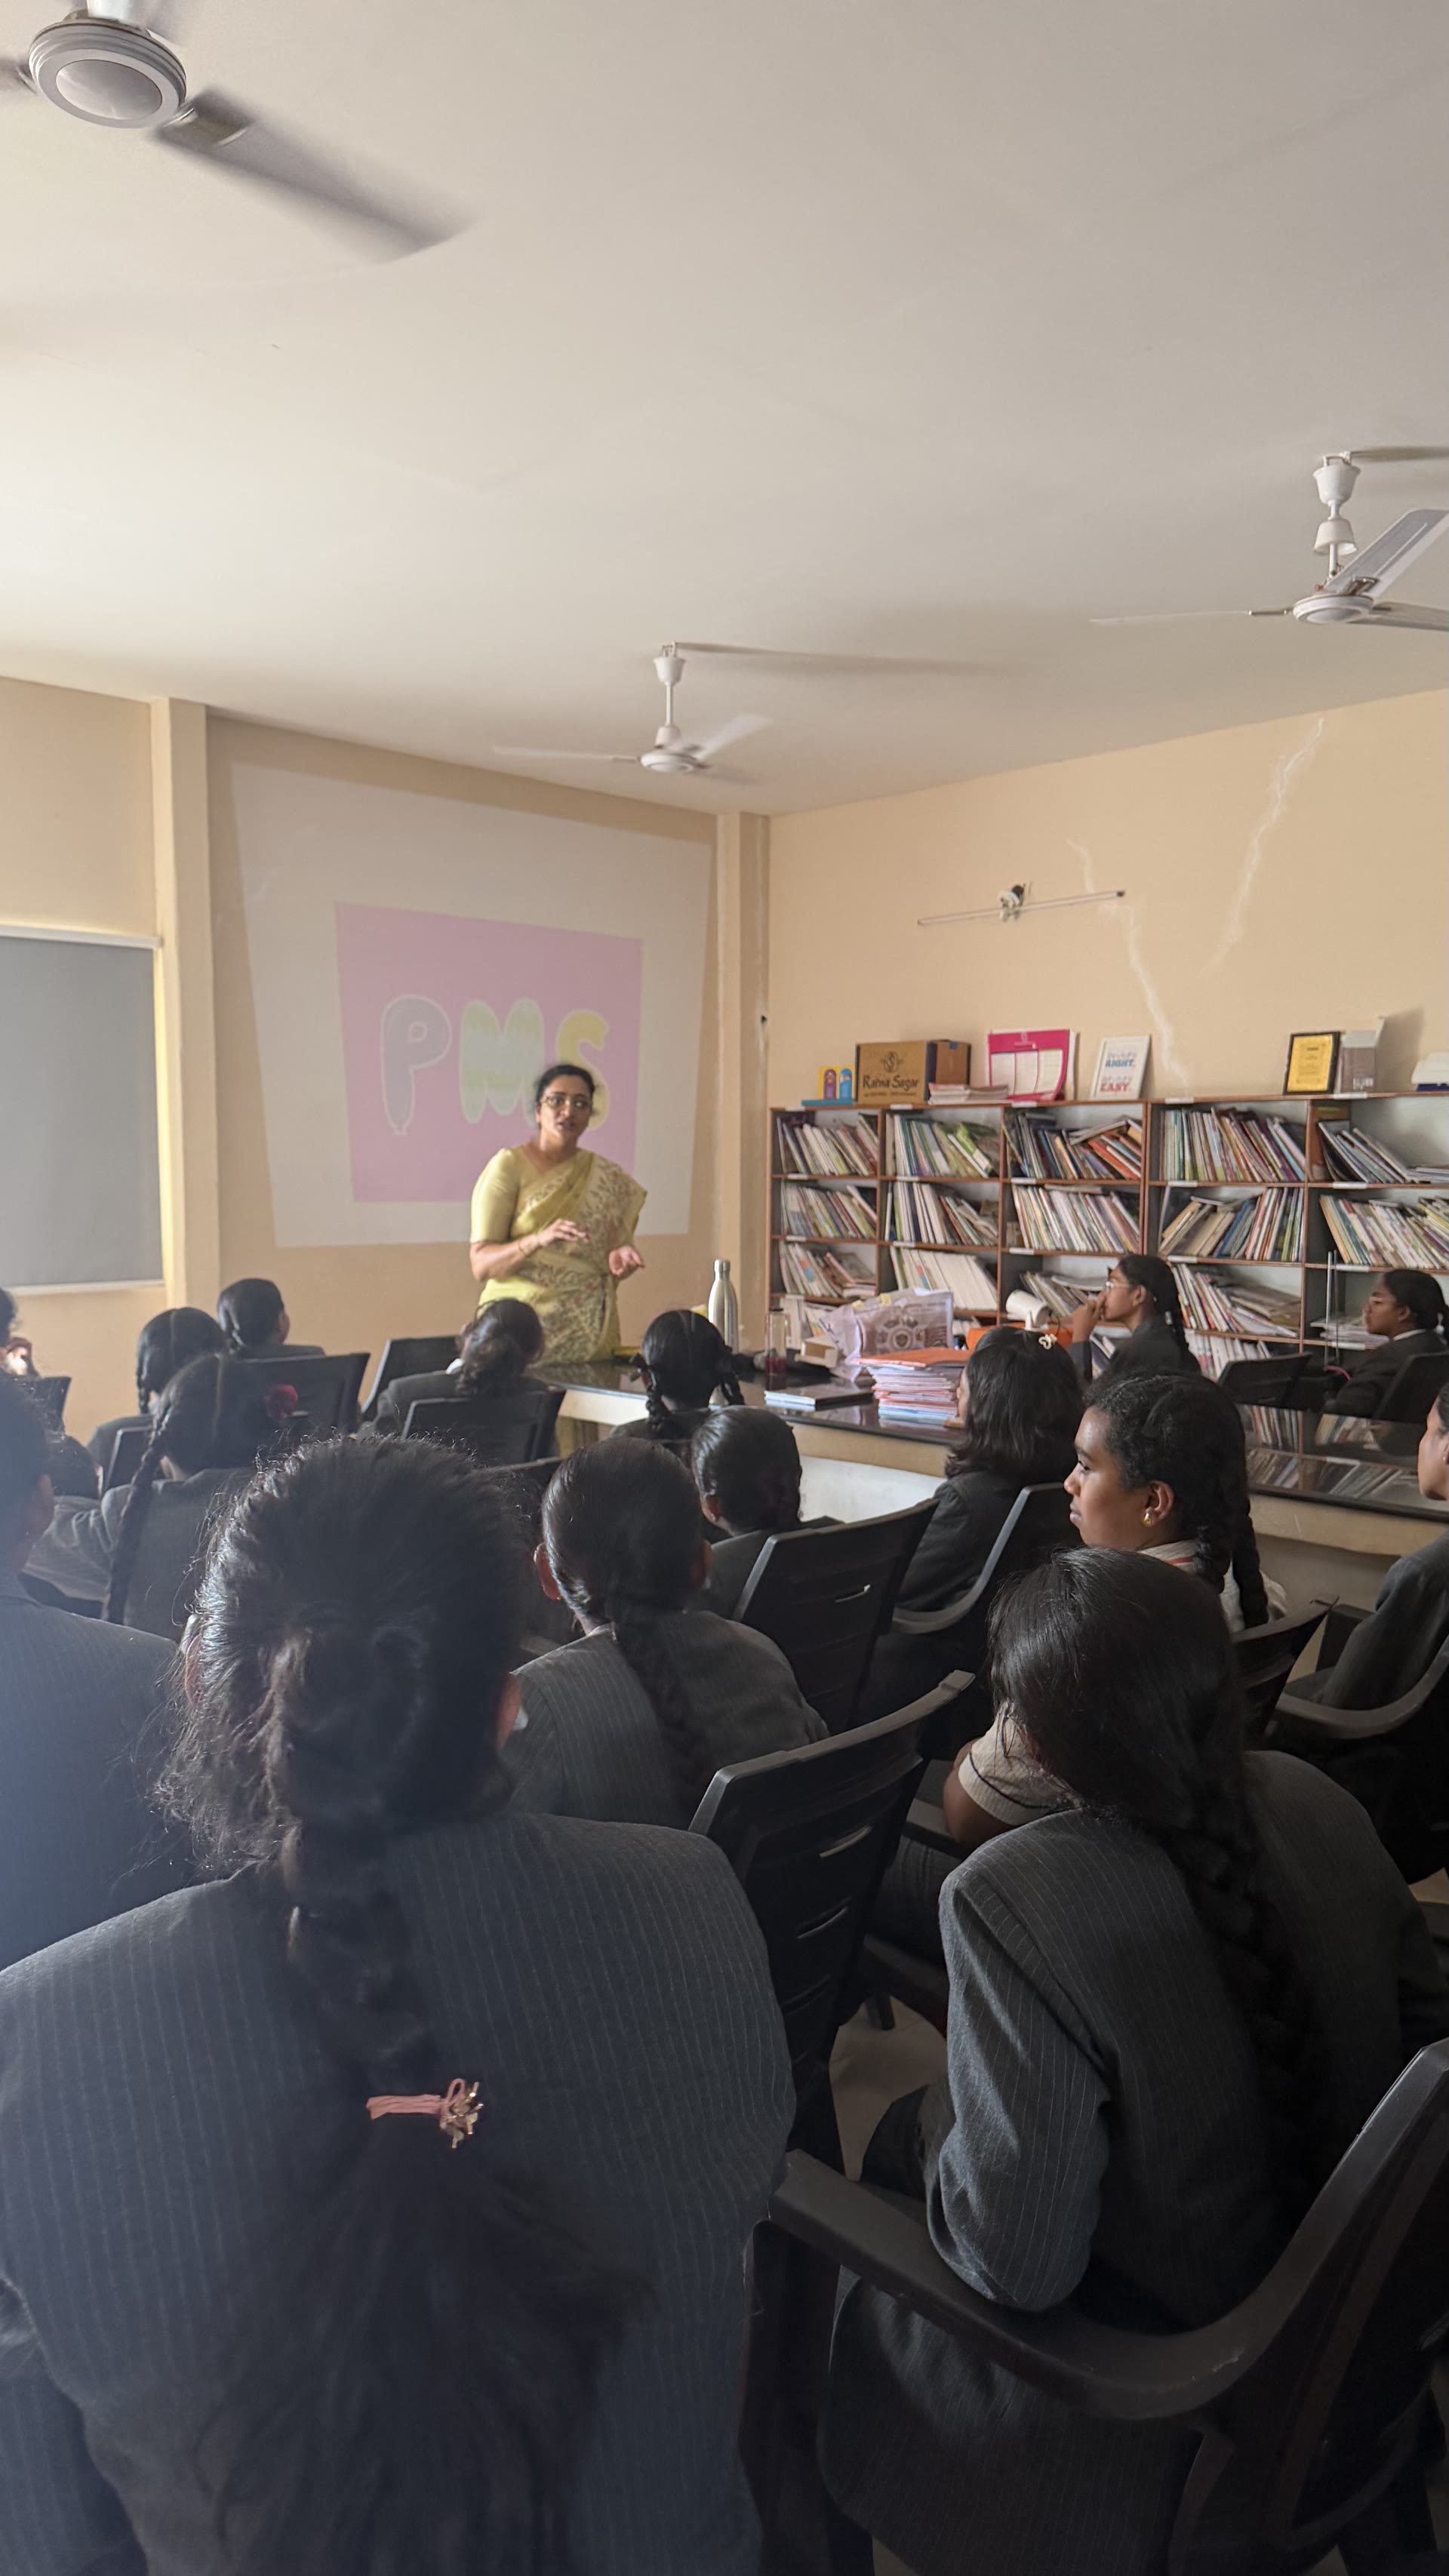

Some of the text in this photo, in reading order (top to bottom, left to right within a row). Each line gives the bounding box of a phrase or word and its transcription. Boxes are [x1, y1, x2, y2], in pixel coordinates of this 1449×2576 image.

[381, 993, 610, 1136] PMS
[863, 1074, 918, 1091] Ratna Sagar
